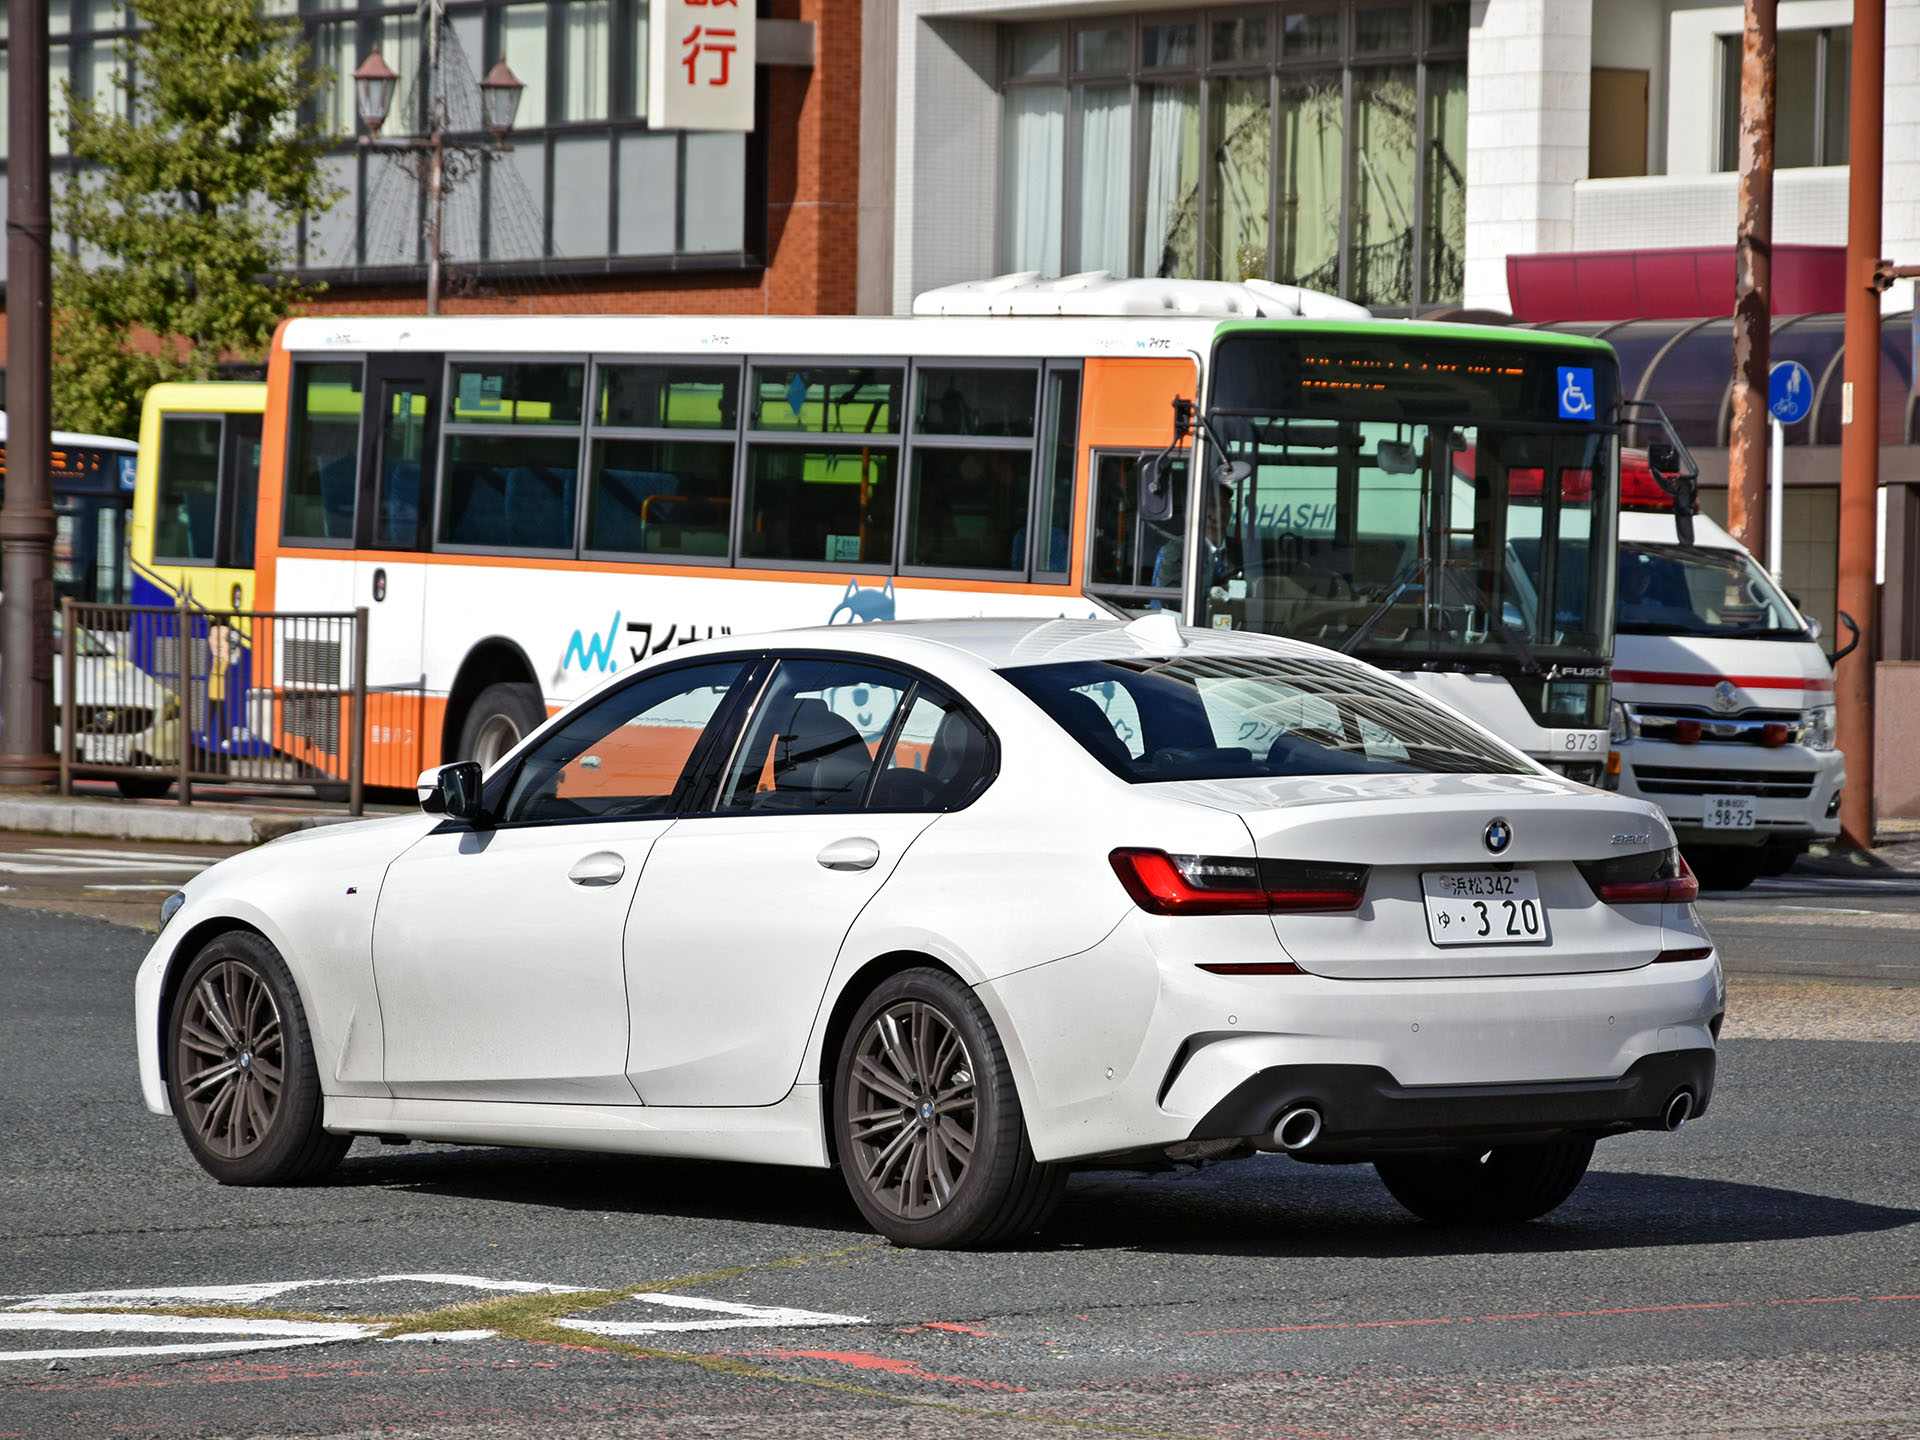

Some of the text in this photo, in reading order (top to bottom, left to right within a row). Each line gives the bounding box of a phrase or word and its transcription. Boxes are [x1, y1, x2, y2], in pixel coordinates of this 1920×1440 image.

[682, 0, 738, 86] 行
[1215, 617, 1230, 627] JR
[1562, 667, 1605, 676] FUSO
[1565, 733, 1597, 751] 873
[1715, 809, 1753, 826] 98-25
